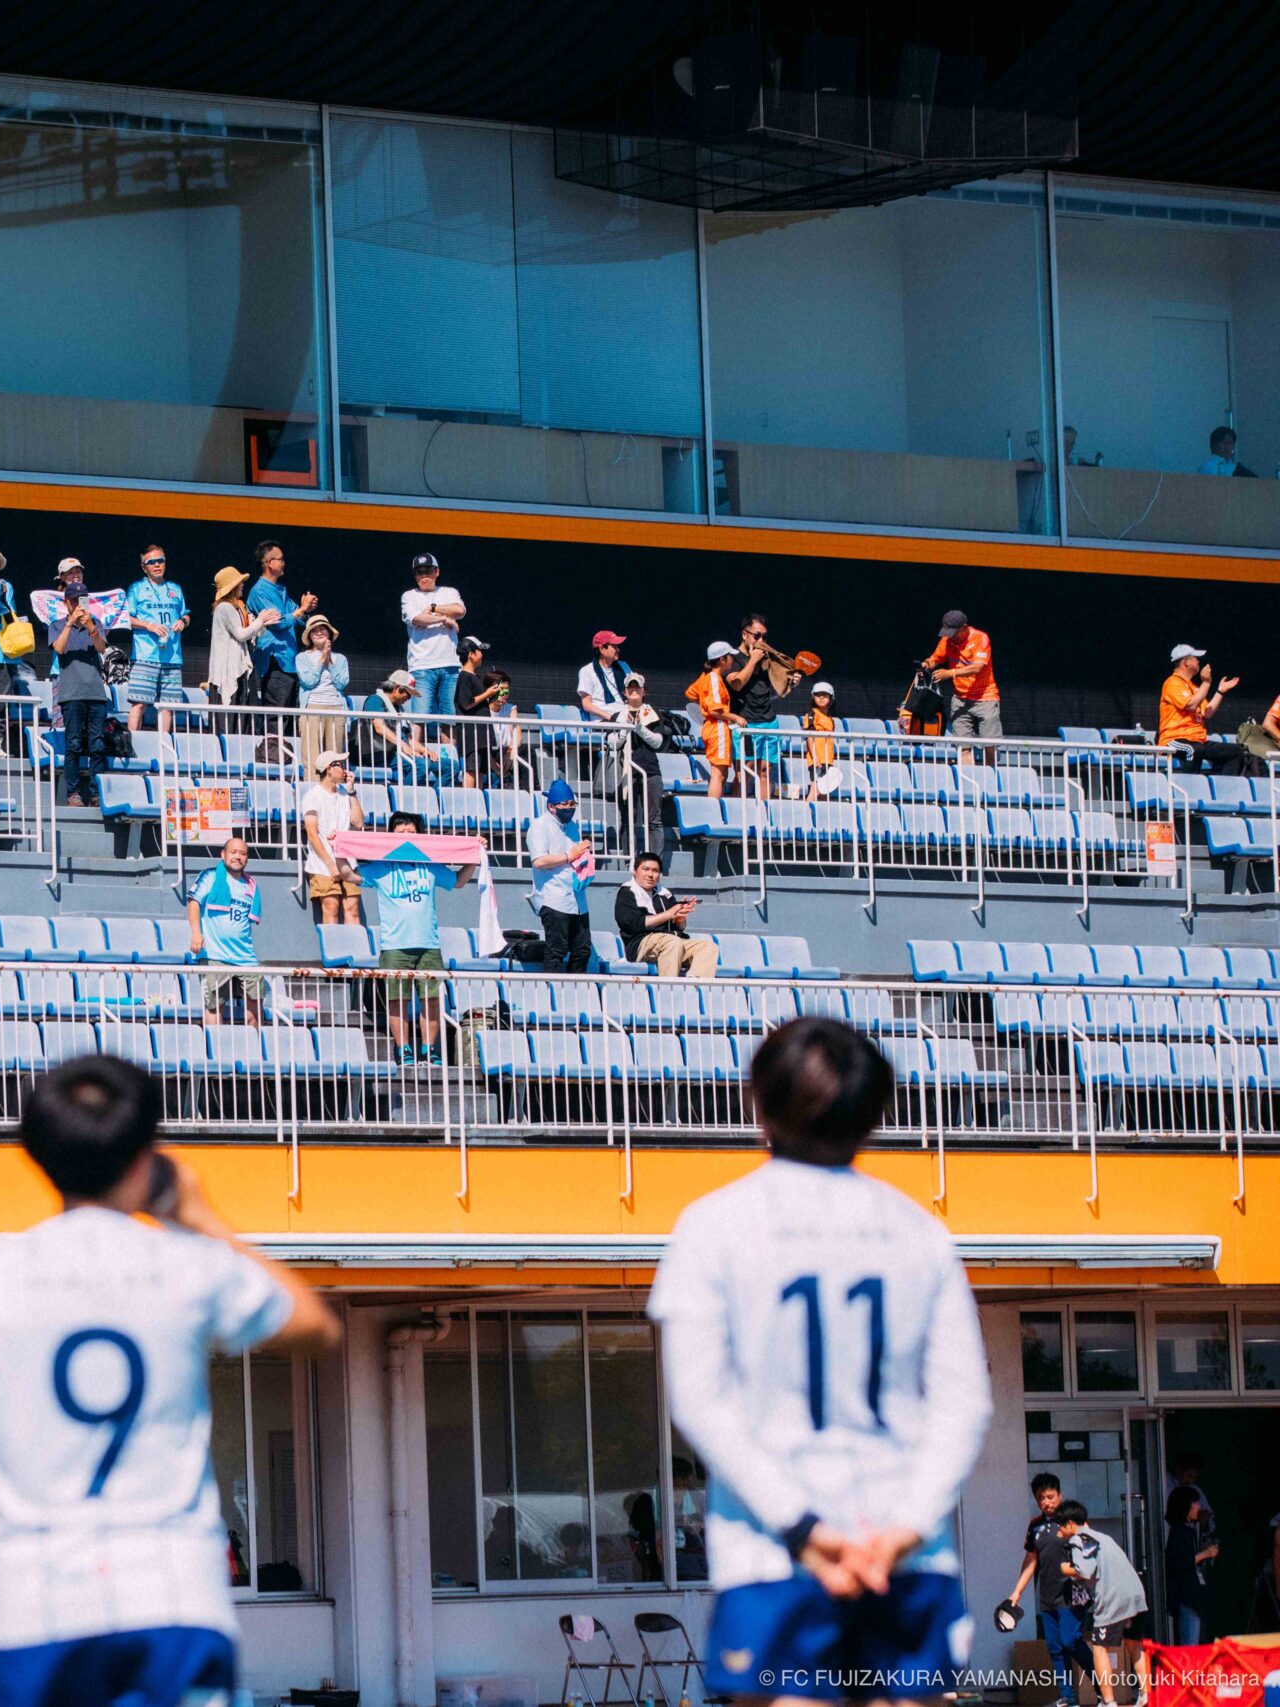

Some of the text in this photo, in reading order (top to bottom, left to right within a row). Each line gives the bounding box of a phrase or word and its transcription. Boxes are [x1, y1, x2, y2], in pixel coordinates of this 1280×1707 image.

[158, 611, 171, 625] 10
[408, 889, 422, 903] 18
[230, 908, 242, 922] 18
[780, 1274, 889, 1433] 11
[53, 1327, 146, 1499] 9
